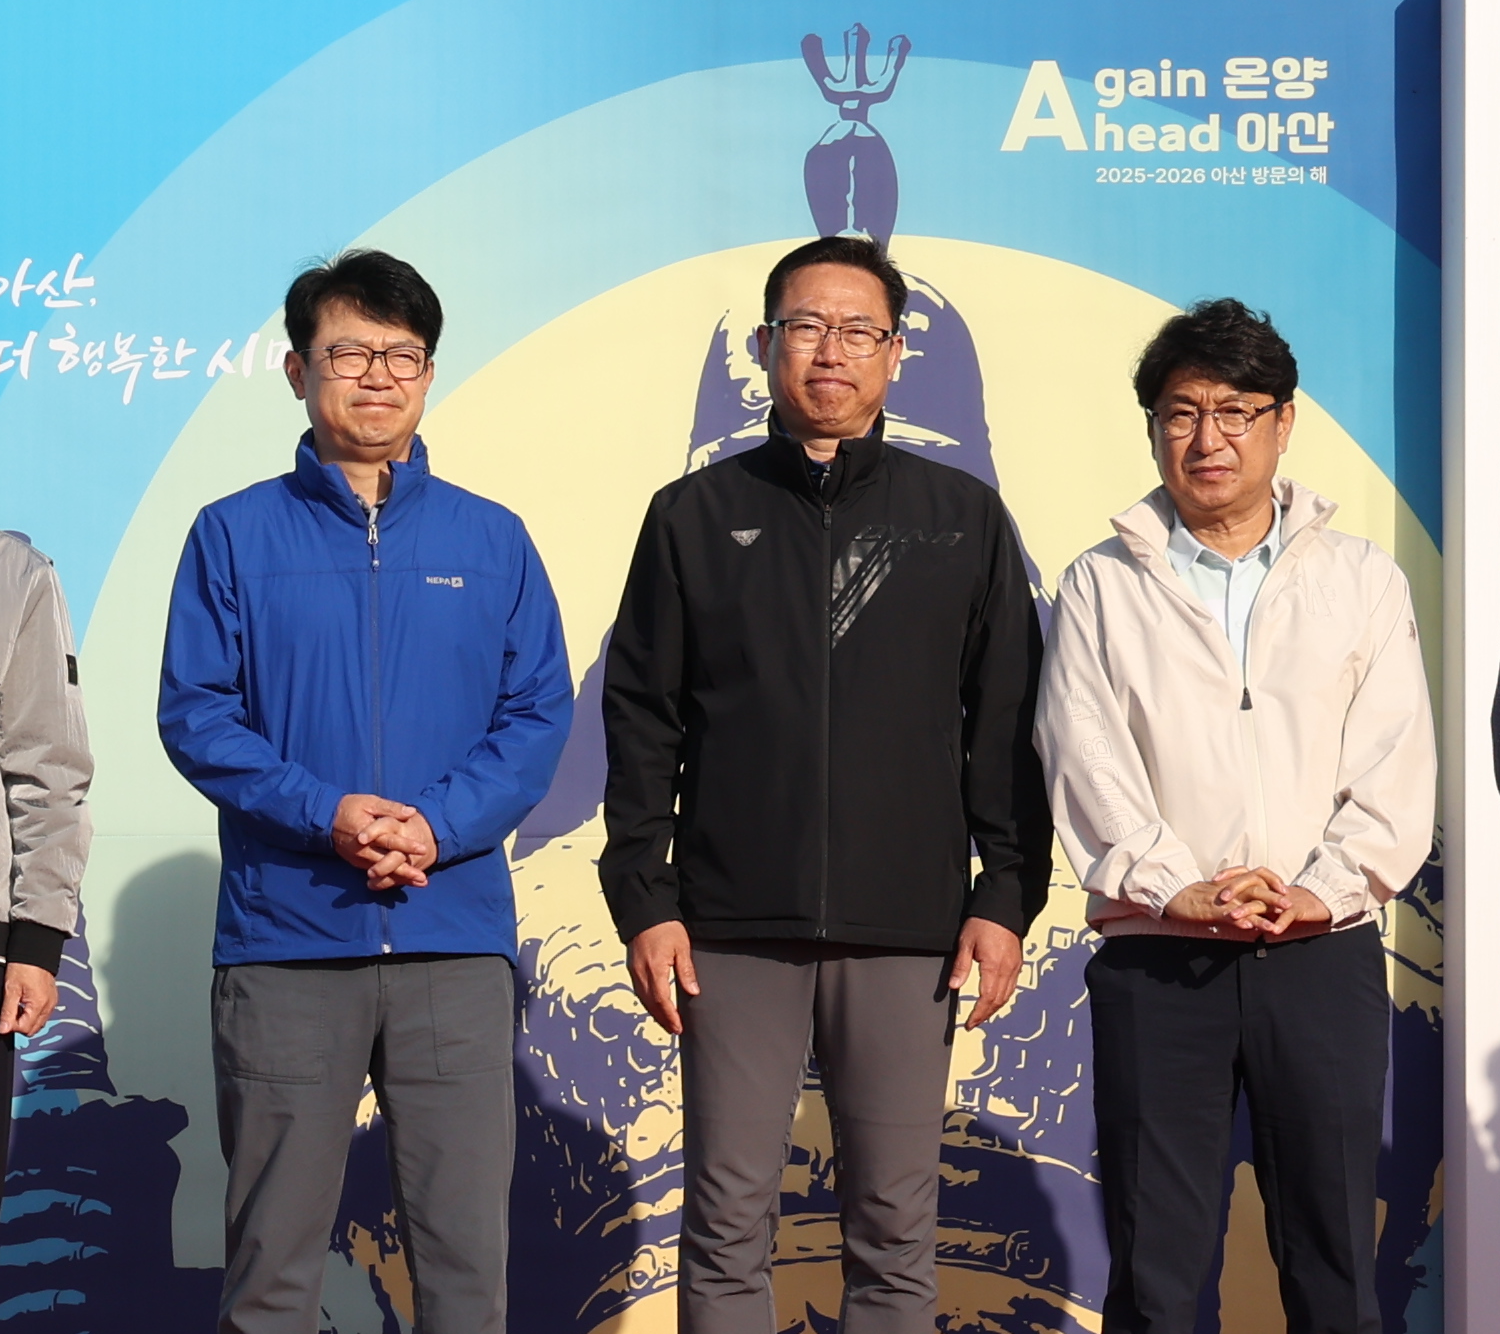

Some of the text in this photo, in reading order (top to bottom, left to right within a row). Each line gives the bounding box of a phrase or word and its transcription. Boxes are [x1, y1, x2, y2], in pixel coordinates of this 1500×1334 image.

[1222, 57, 1328, 99] 온양
[1236, 112, 1335, 153] 아산
[1095, 166, 1327, 185] 2025-2026 아산 방문의 해
[48, 323, 197, 405] 행복한
